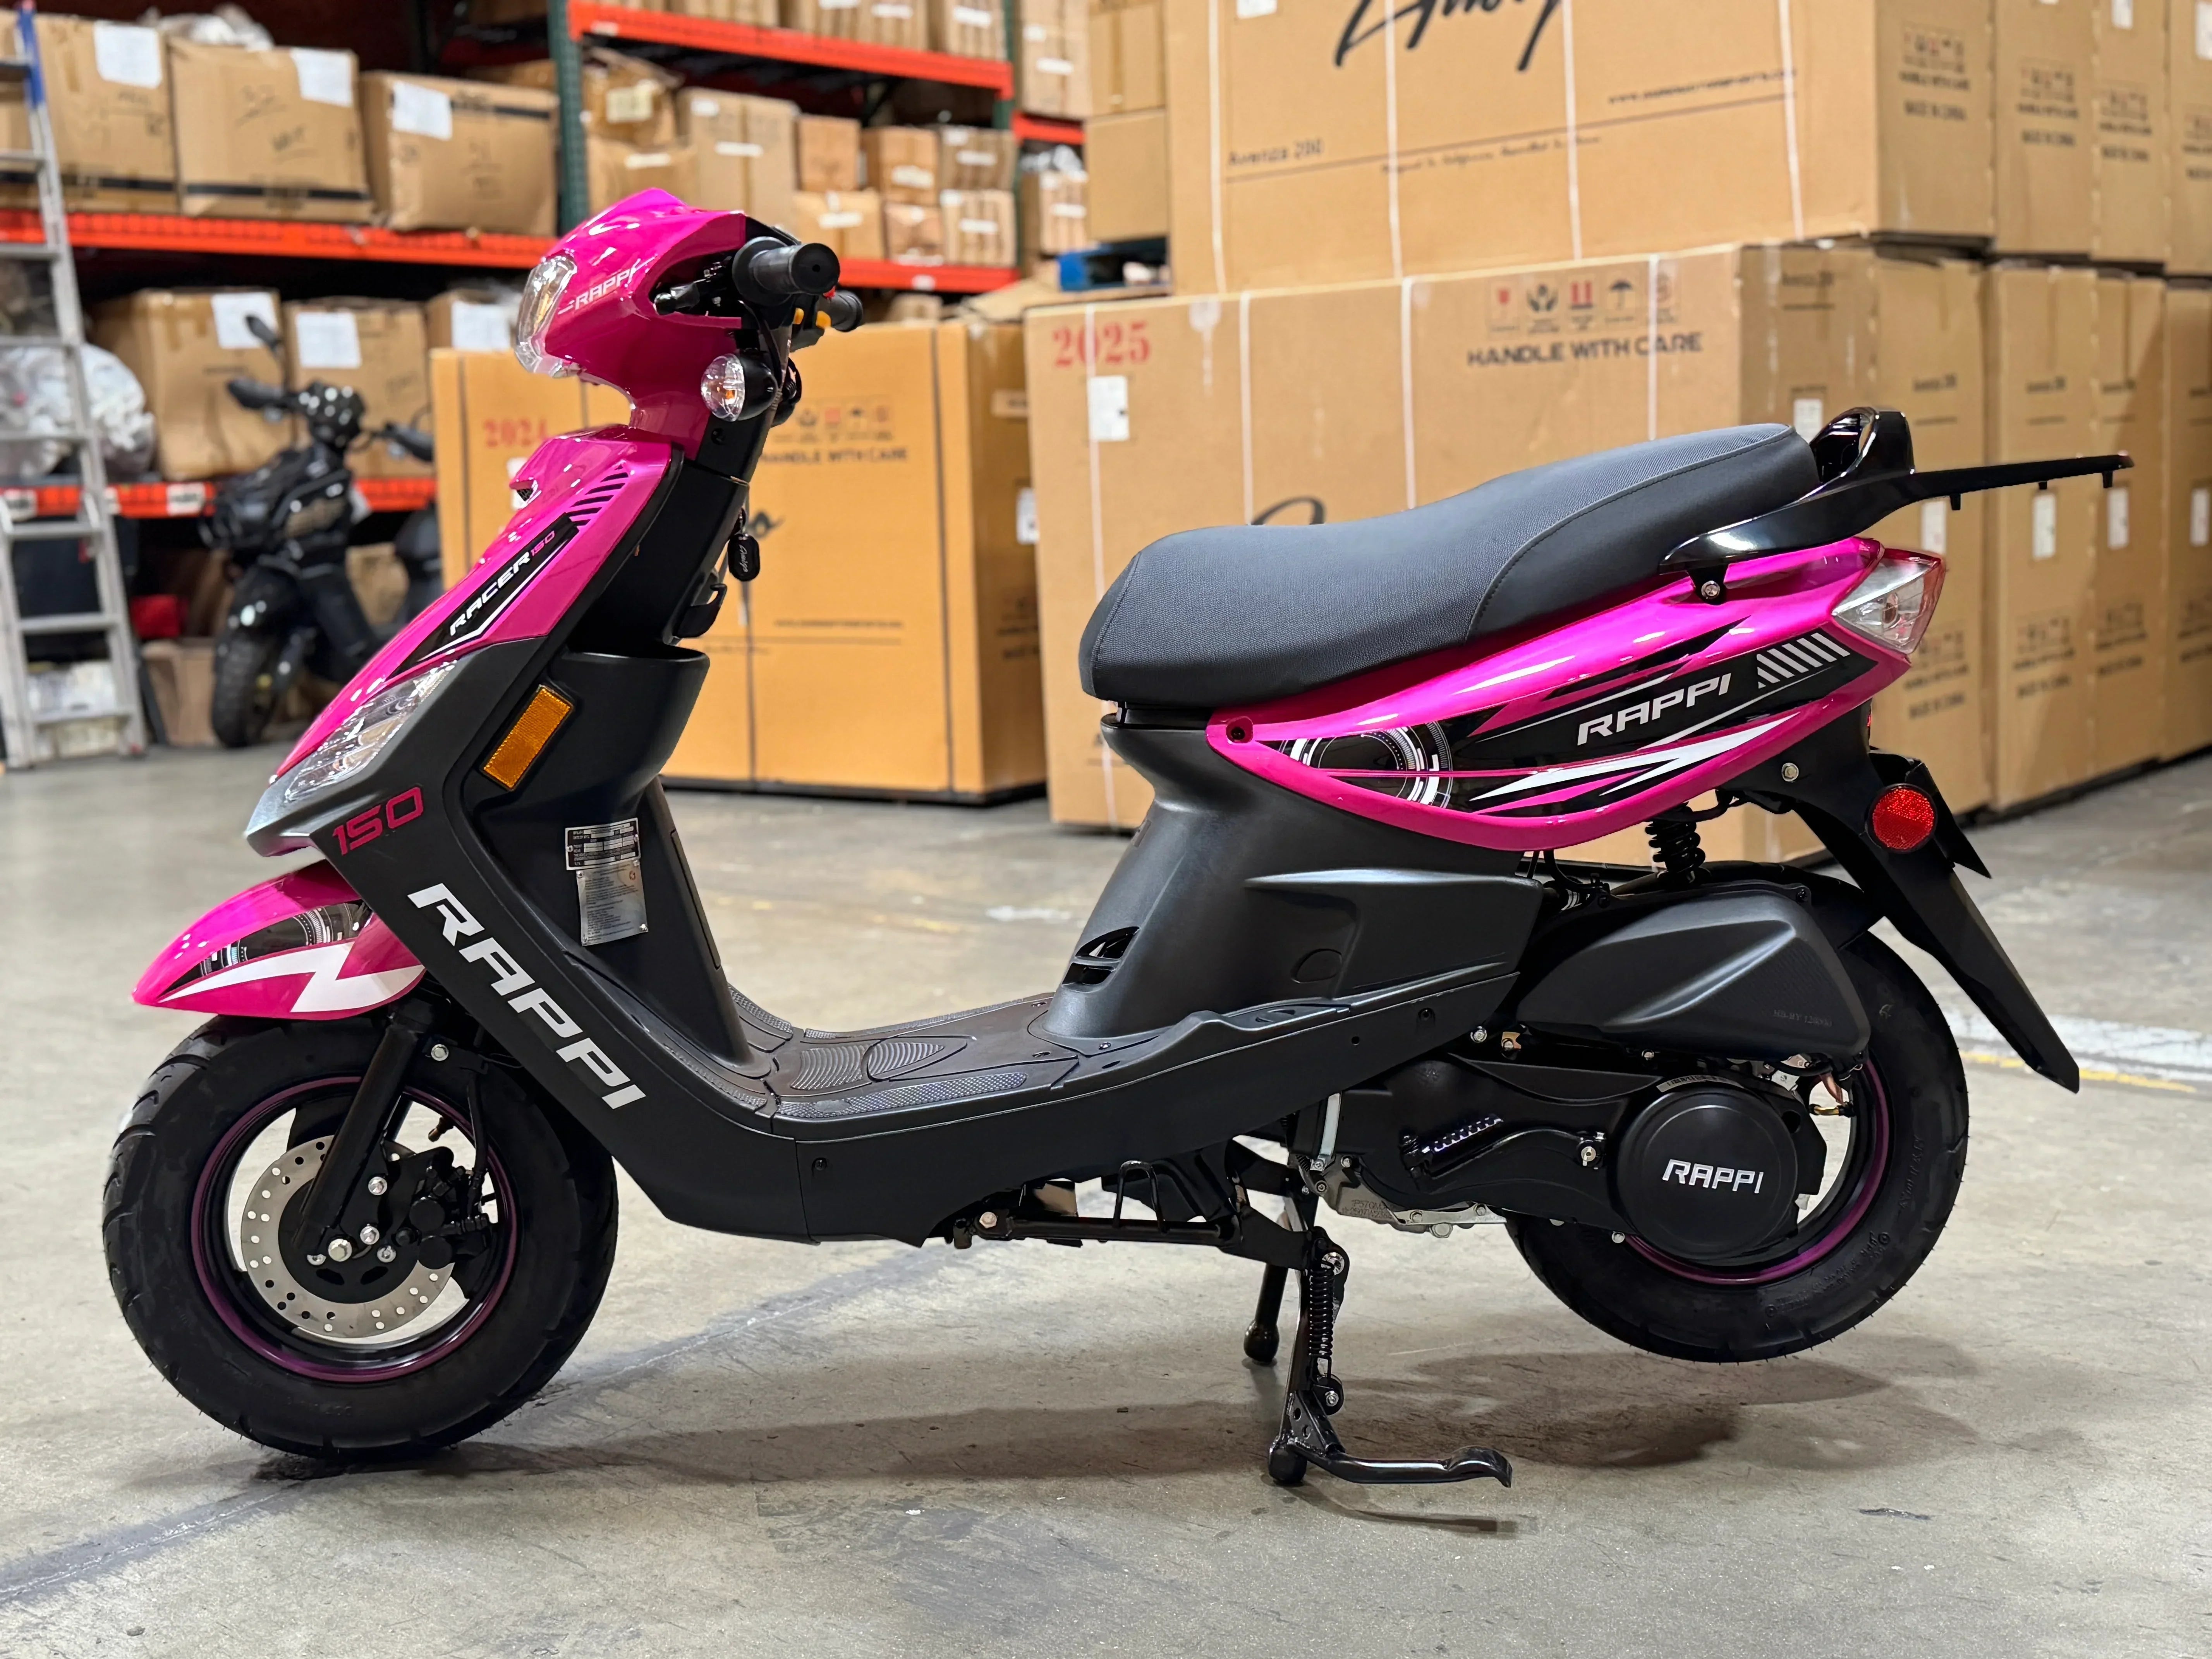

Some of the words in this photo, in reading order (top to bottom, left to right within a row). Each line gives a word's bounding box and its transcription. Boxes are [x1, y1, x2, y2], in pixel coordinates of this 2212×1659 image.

[1052, 321, 1151, 368] 2025
[1467, 342, 1565, 366] HANDLE
[1570, 337, 1631, 359] WITH
[1635, 331, 1703, 356] CARE
[450, 551, 530, 636] RACER
[531, 530, 555, 556] 150
[1577, 673, 1731, 746] RAPPI
[332, 787, 424, 856] 150
[407, 883, 646, 1109] RAPPI
[1662, 1159, 1764, 1194] RAPPI
